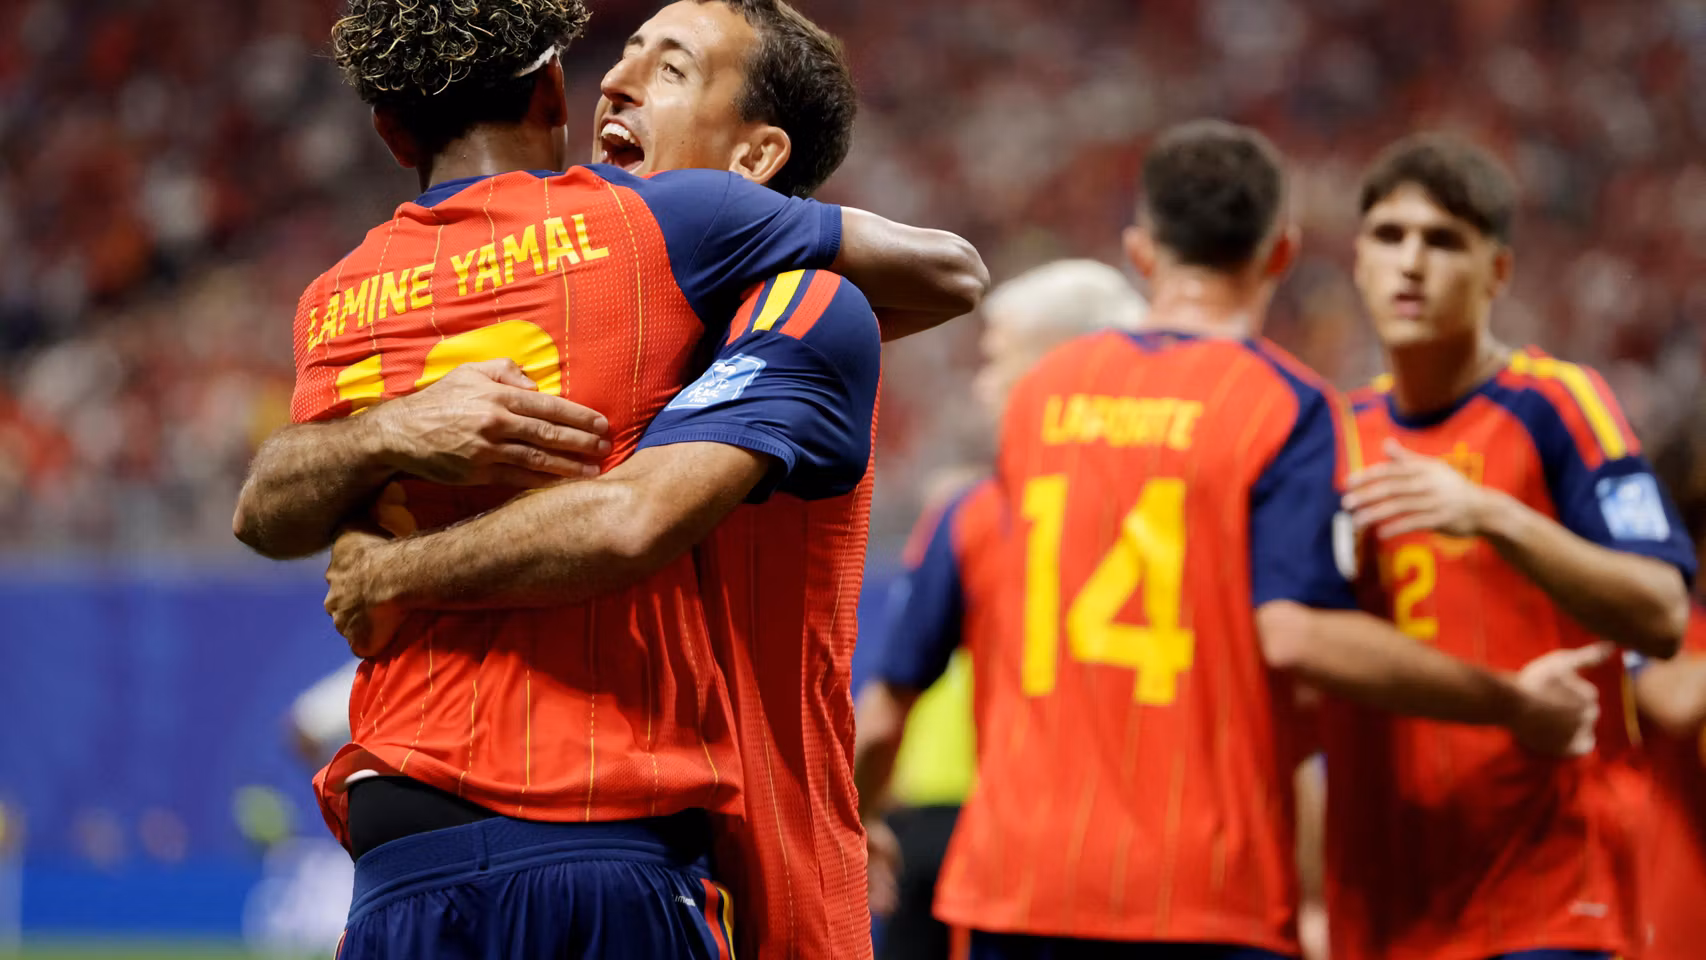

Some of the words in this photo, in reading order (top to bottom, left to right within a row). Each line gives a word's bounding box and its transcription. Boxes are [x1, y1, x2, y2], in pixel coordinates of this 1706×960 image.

[308, 262, 436, 353] LAMINE
[450, 213, 610, 297] YAMAL
[1021, 473, 1195, 706] 14
